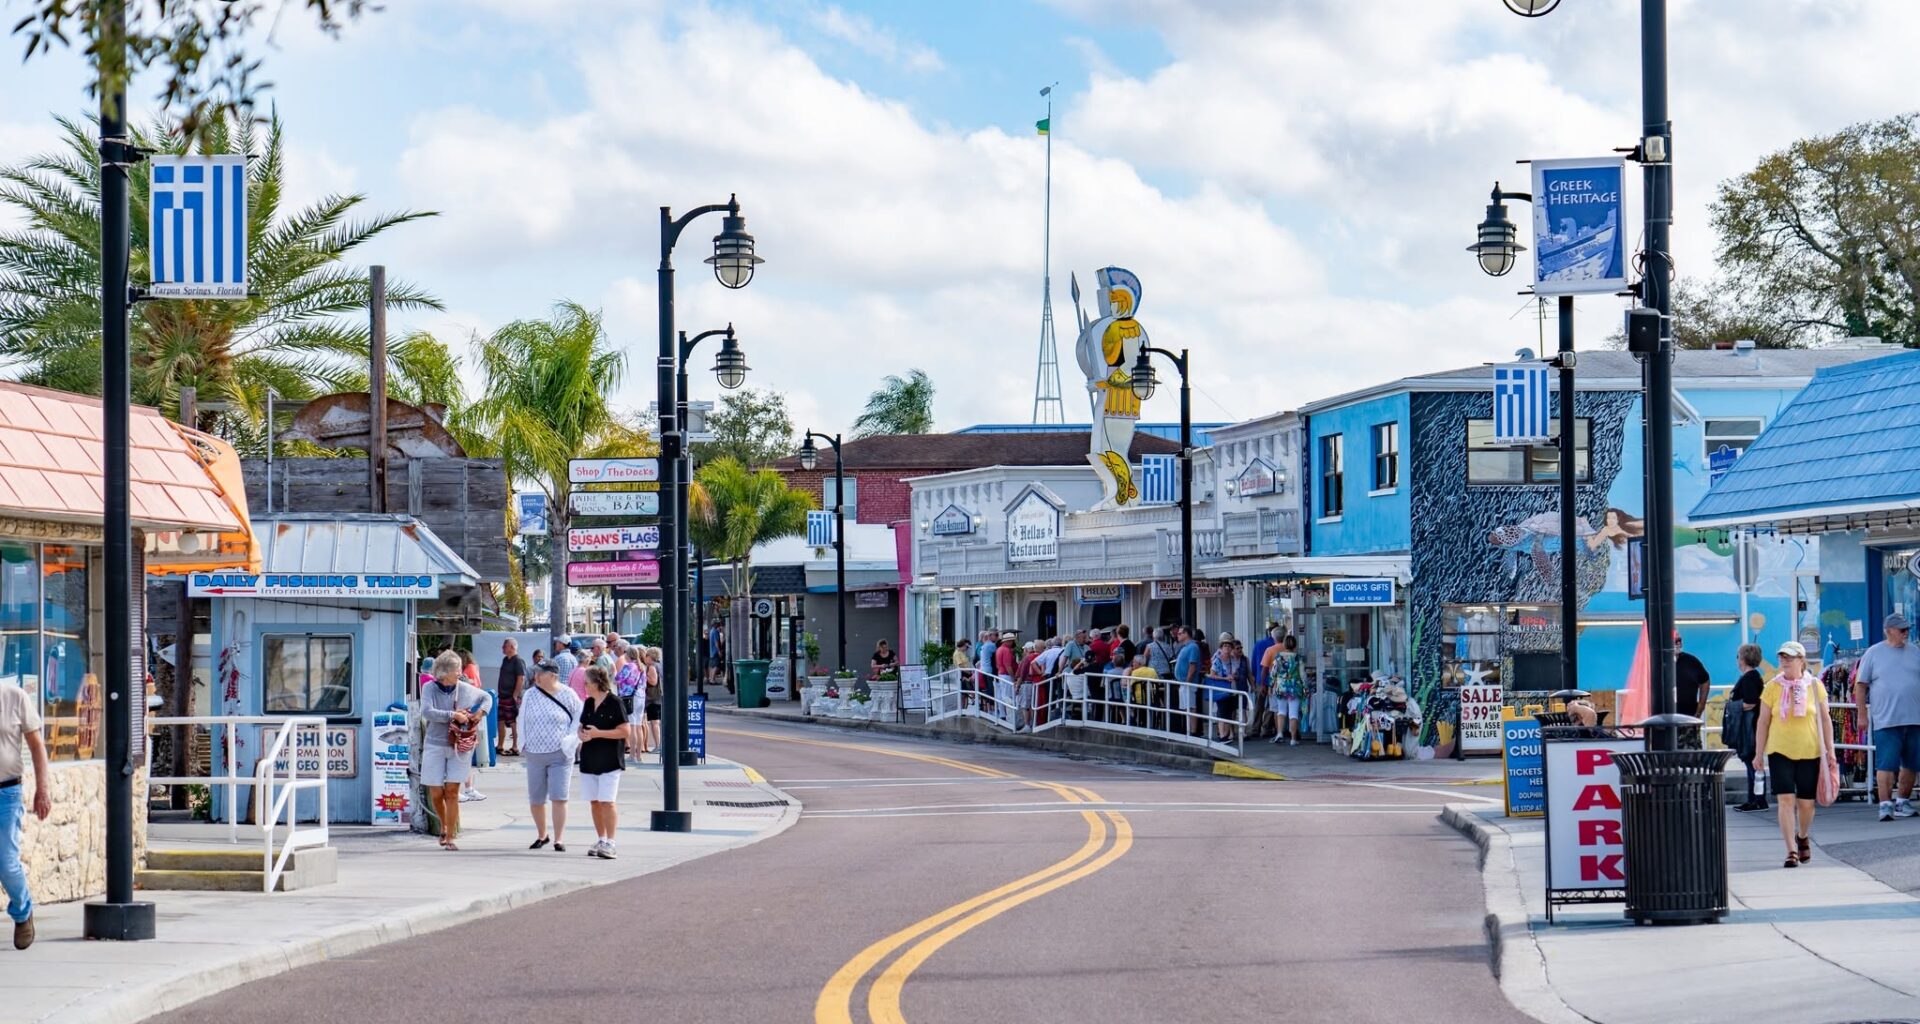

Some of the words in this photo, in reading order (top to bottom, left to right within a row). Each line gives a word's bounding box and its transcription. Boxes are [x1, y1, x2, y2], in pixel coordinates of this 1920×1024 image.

[1549, 180, 1592, 191] GREEK
[1550, 192, 1617, 205] HERITAGE
[154, 286, 180, 296] Tarpon
[183, 286, 213, 296] Springs,
[217, 286, 243, 295] Florida
[575, 467, 600, 477] Shop
[607, 467, 624, 477] The
[625, 468, 654, 476] Docks
[613, 501, 648, 511] BAR
[1020, 525, 1045, 541] Hellas
[570, 533, 620, 546] SUSAN'S
[621, 532, 659, 544] FLAGS
[1010, 541, 1056, 557] Restaurant
[194, 575, 259, 587] DAILY
[265, 575, 358, 588] FISHING
[365, 575, 432, 588] TRIPS
[1086, 587, 1116, 595] HELLAS
[1335, 583, 1368, 592] GLORIA'S
[1370, 583, 1389, 592] GIFTS
[1462, 689, 1502, 703] SALE
[1506, 728, 1542, 740] ODYS
[1510, 744, 1542, 756] CRUI
[296, 760, 349, 771] GEOGES
[1508, 767, 1543, 777] TICKETS
[1520, 804, 1535, 812] STOP
